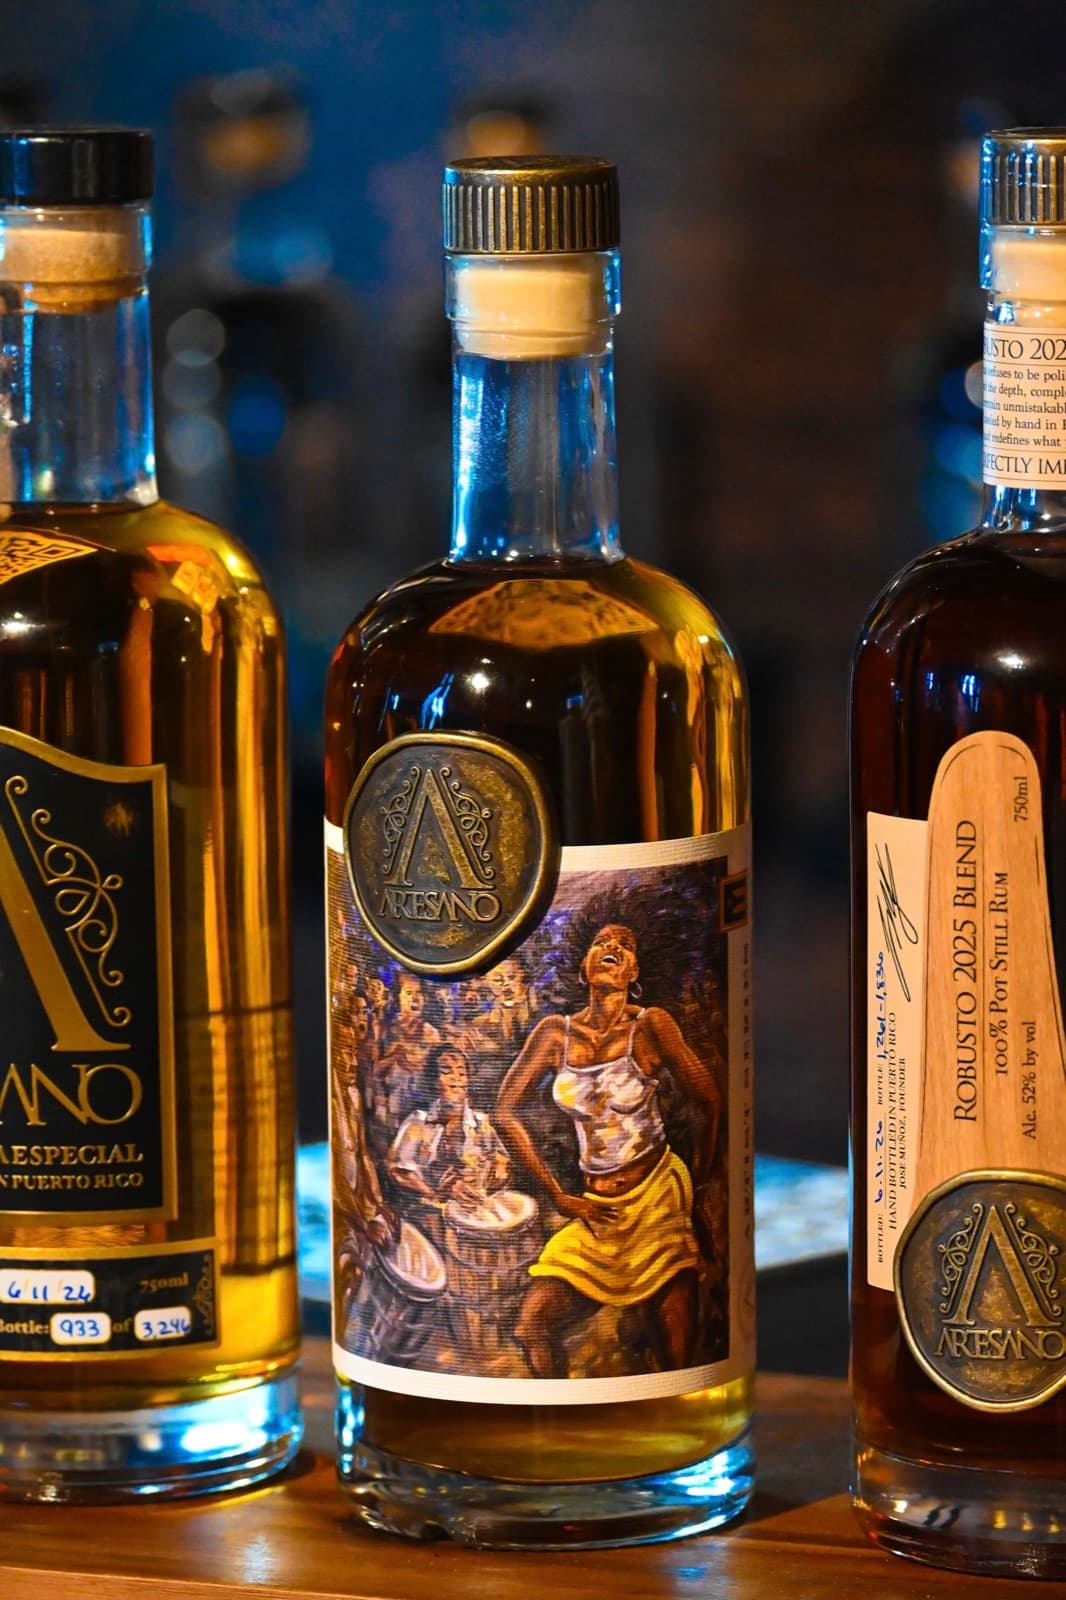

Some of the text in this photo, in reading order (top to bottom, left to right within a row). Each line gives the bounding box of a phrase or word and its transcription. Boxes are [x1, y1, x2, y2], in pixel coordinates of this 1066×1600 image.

[1014, 370, 1024, 380] to
[1026, 368, 1040, 380] be
[998, 383, 1027, 397] depth,
[1001, 416, 1012, 430] by
[1015, 417, 1041, 430] hand
[1046, 419, 1057, 430] in
[1033, 435, 1061, 447] what
[1014, 776, 1028, 823] 750ml
[953, 820, 977, 1122] ROBUSTO 2025 BLEND
[989, 1019, 1008, 1076] 100%
[1022, 1021, 1039, 1140] Alc. 52% by vol
[888, 1012, 897, 1230] HAND BOTTLED IN PUERTO RICO
[11, 1174, 90, 1191] PUERTO
[93, 1172, 144, 1189] RICO
[899, 1163, 907, 1189] JOSE
[139, 1272, 189, 1292] 750ml
[60, 1319, 100, 1337] 933
[112, 1317, 132, 1333] of
